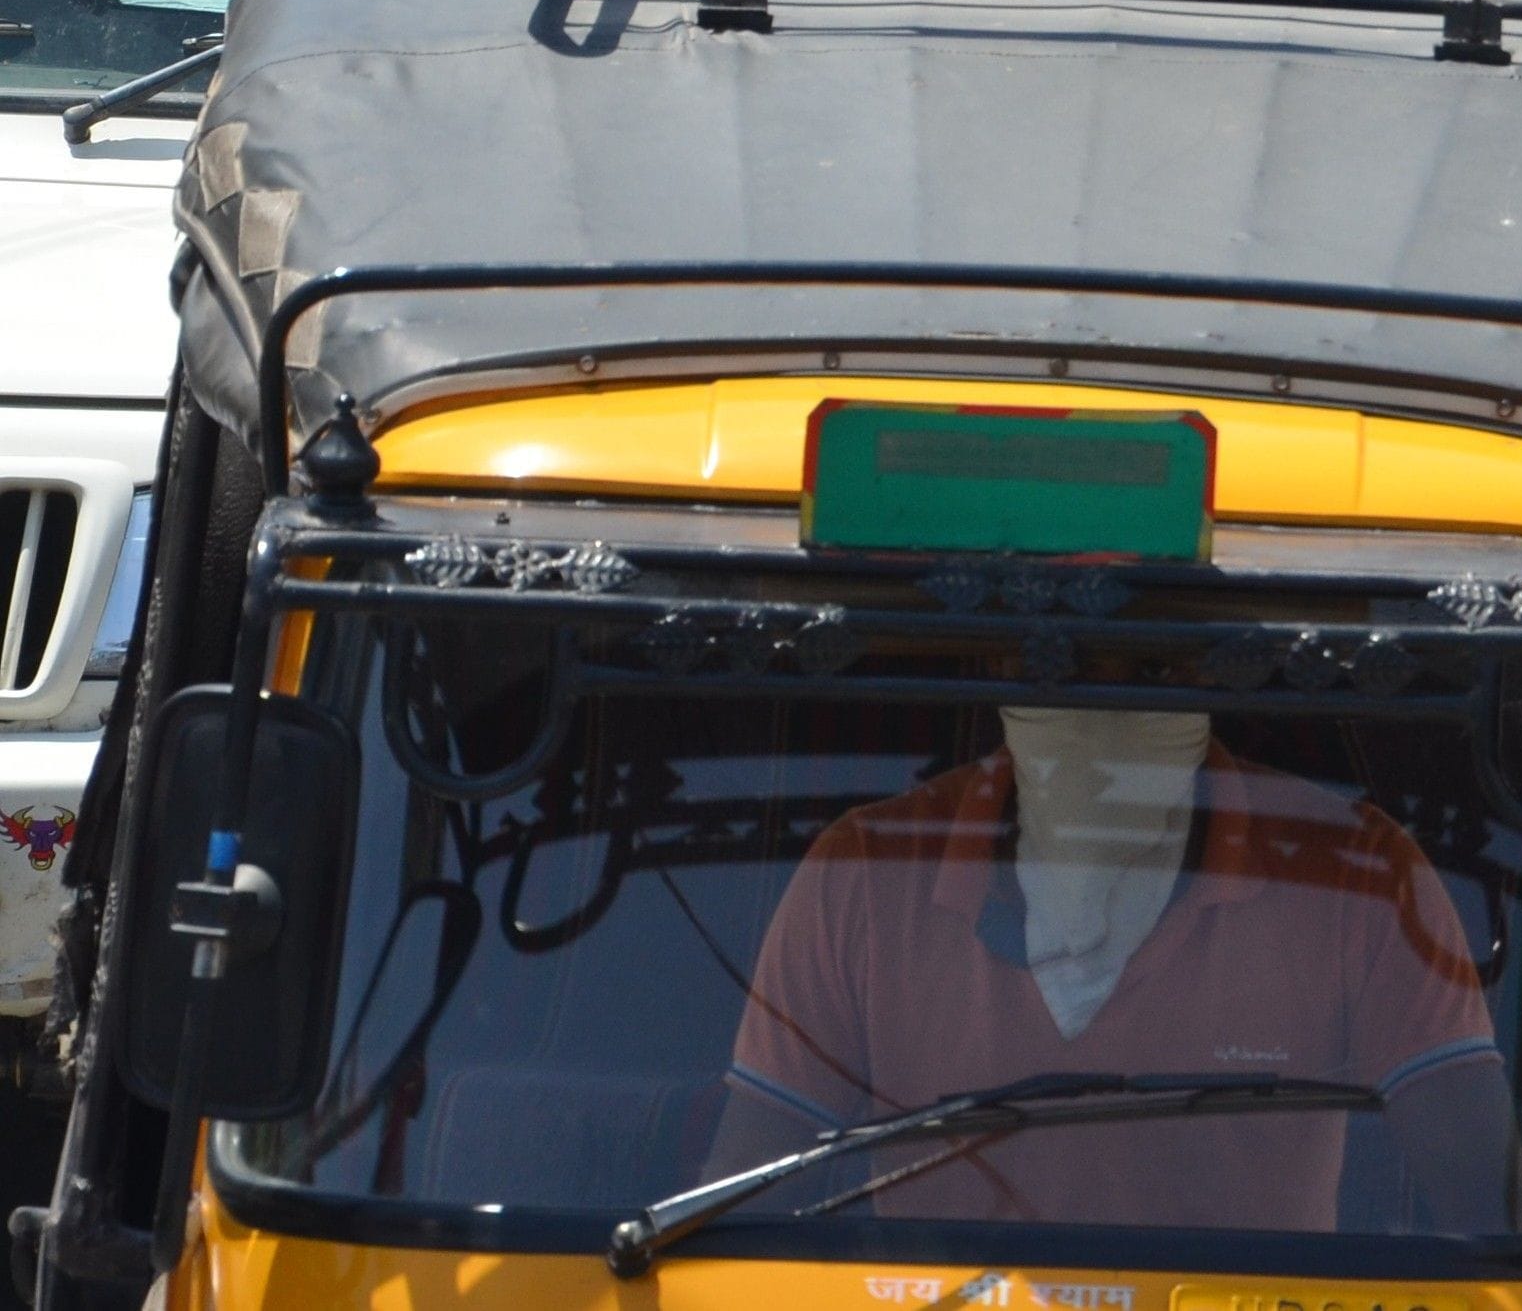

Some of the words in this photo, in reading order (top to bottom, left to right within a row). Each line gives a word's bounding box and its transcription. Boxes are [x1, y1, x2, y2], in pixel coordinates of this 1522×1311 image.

[864, 1277, 943, 1304] जय
[959, 1272, 1012, 1307] श्री
[1029, 1282, 1136, 1311] श्याम
